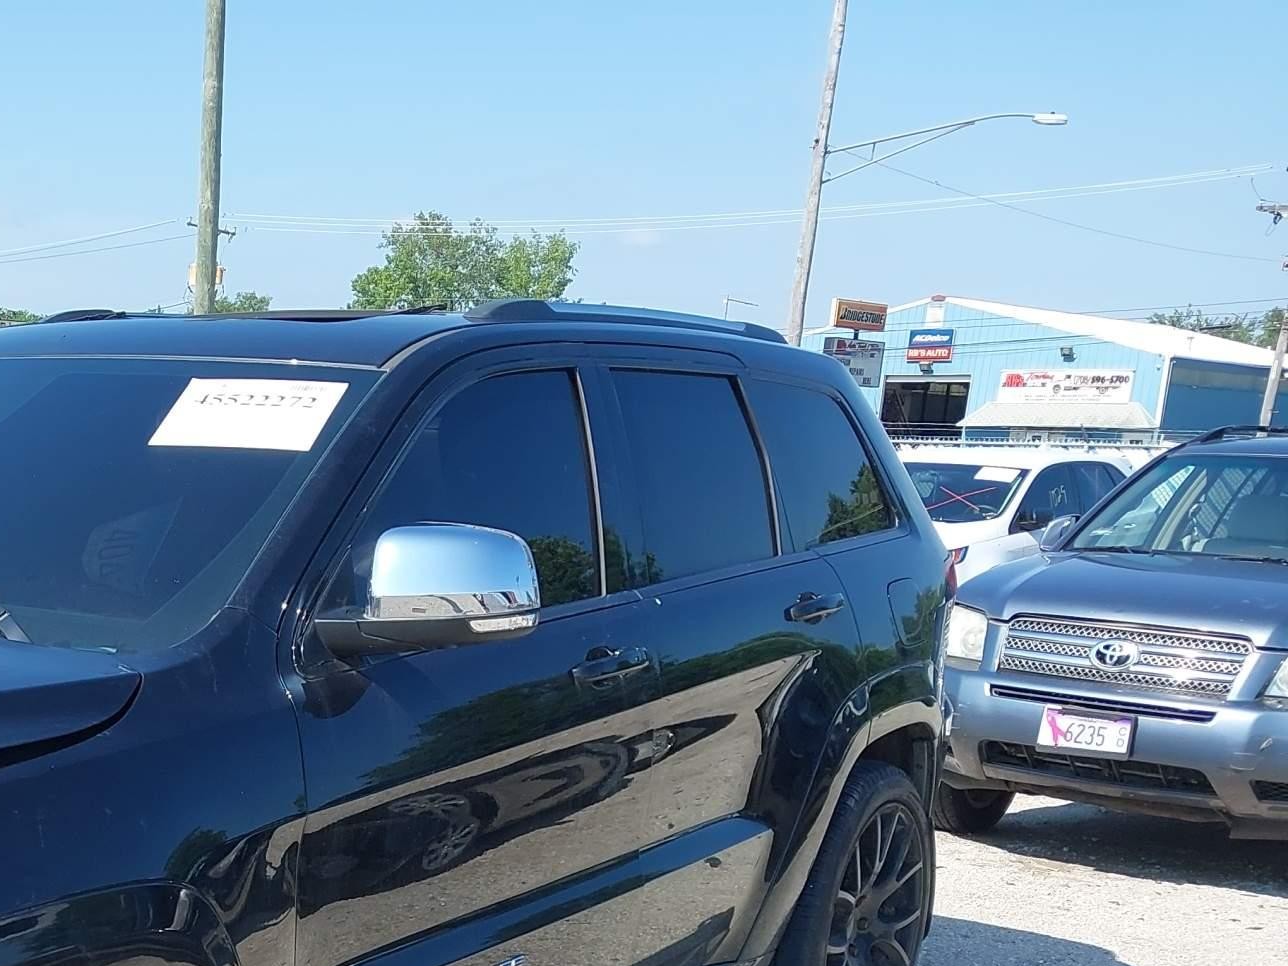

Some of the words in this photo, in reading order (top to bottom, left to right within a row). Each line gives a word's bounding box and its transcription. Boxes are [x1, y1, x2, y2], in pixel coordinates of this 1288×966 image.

[840, 306, 885, 325] BRIDGESTONE
[912, 334, 950, 343] ACDelco
[926, 349, 950, 357] AUTO
[194, 393, 318, 409] 45522272
[1064, 722, 1108, 747] 6235
